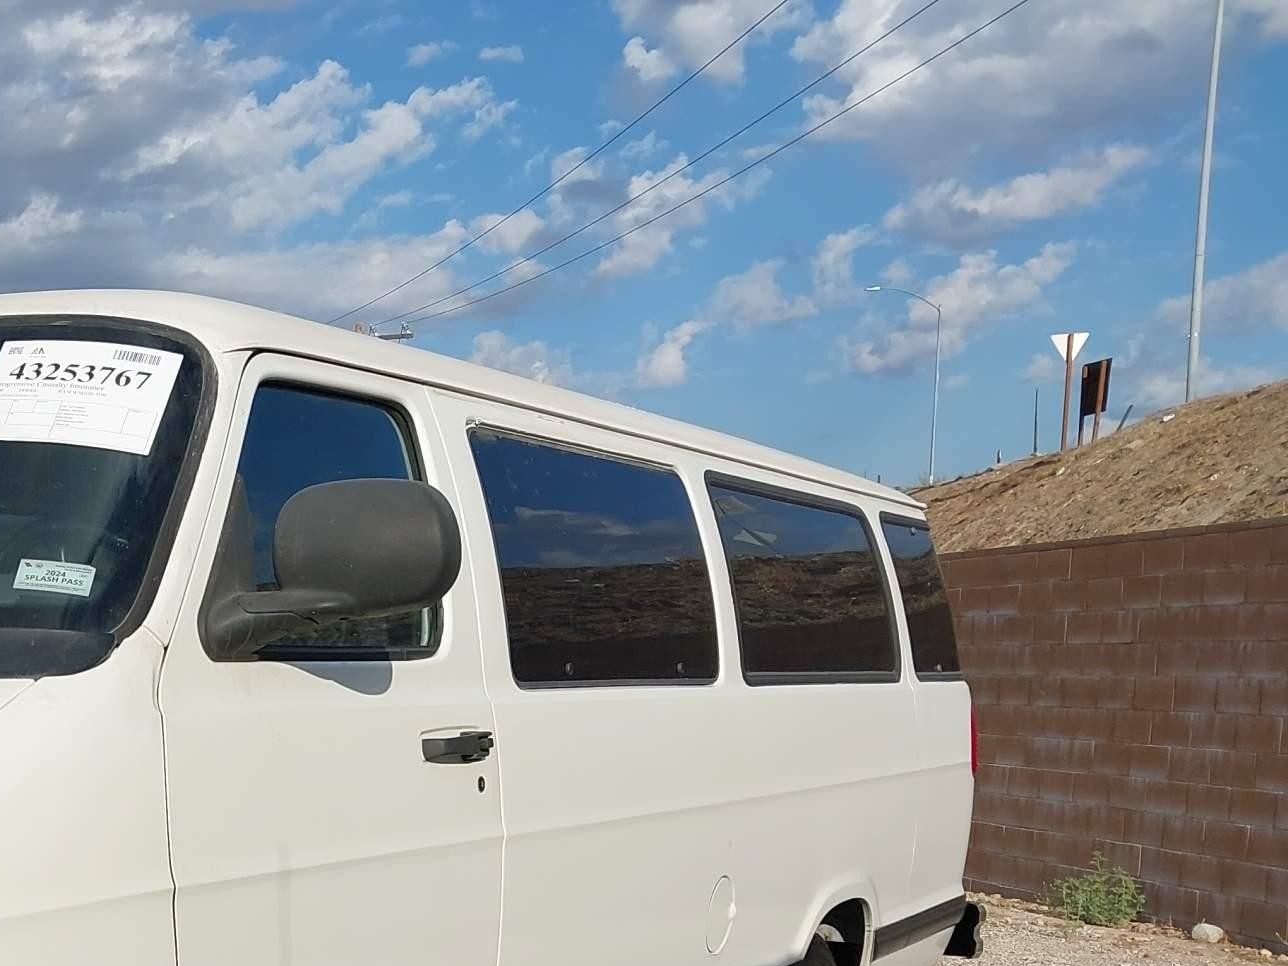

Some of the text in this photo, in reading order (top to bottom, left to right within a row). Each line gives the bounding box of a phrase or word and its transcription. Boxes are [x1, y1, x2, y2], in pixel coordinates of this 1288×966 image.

[9, 362, 153, 390] 43253767
[24, 574, 59, 583] SPLASH
[61, 577, 85, 587] PASS
[45, 570, 66, 578] 2024
